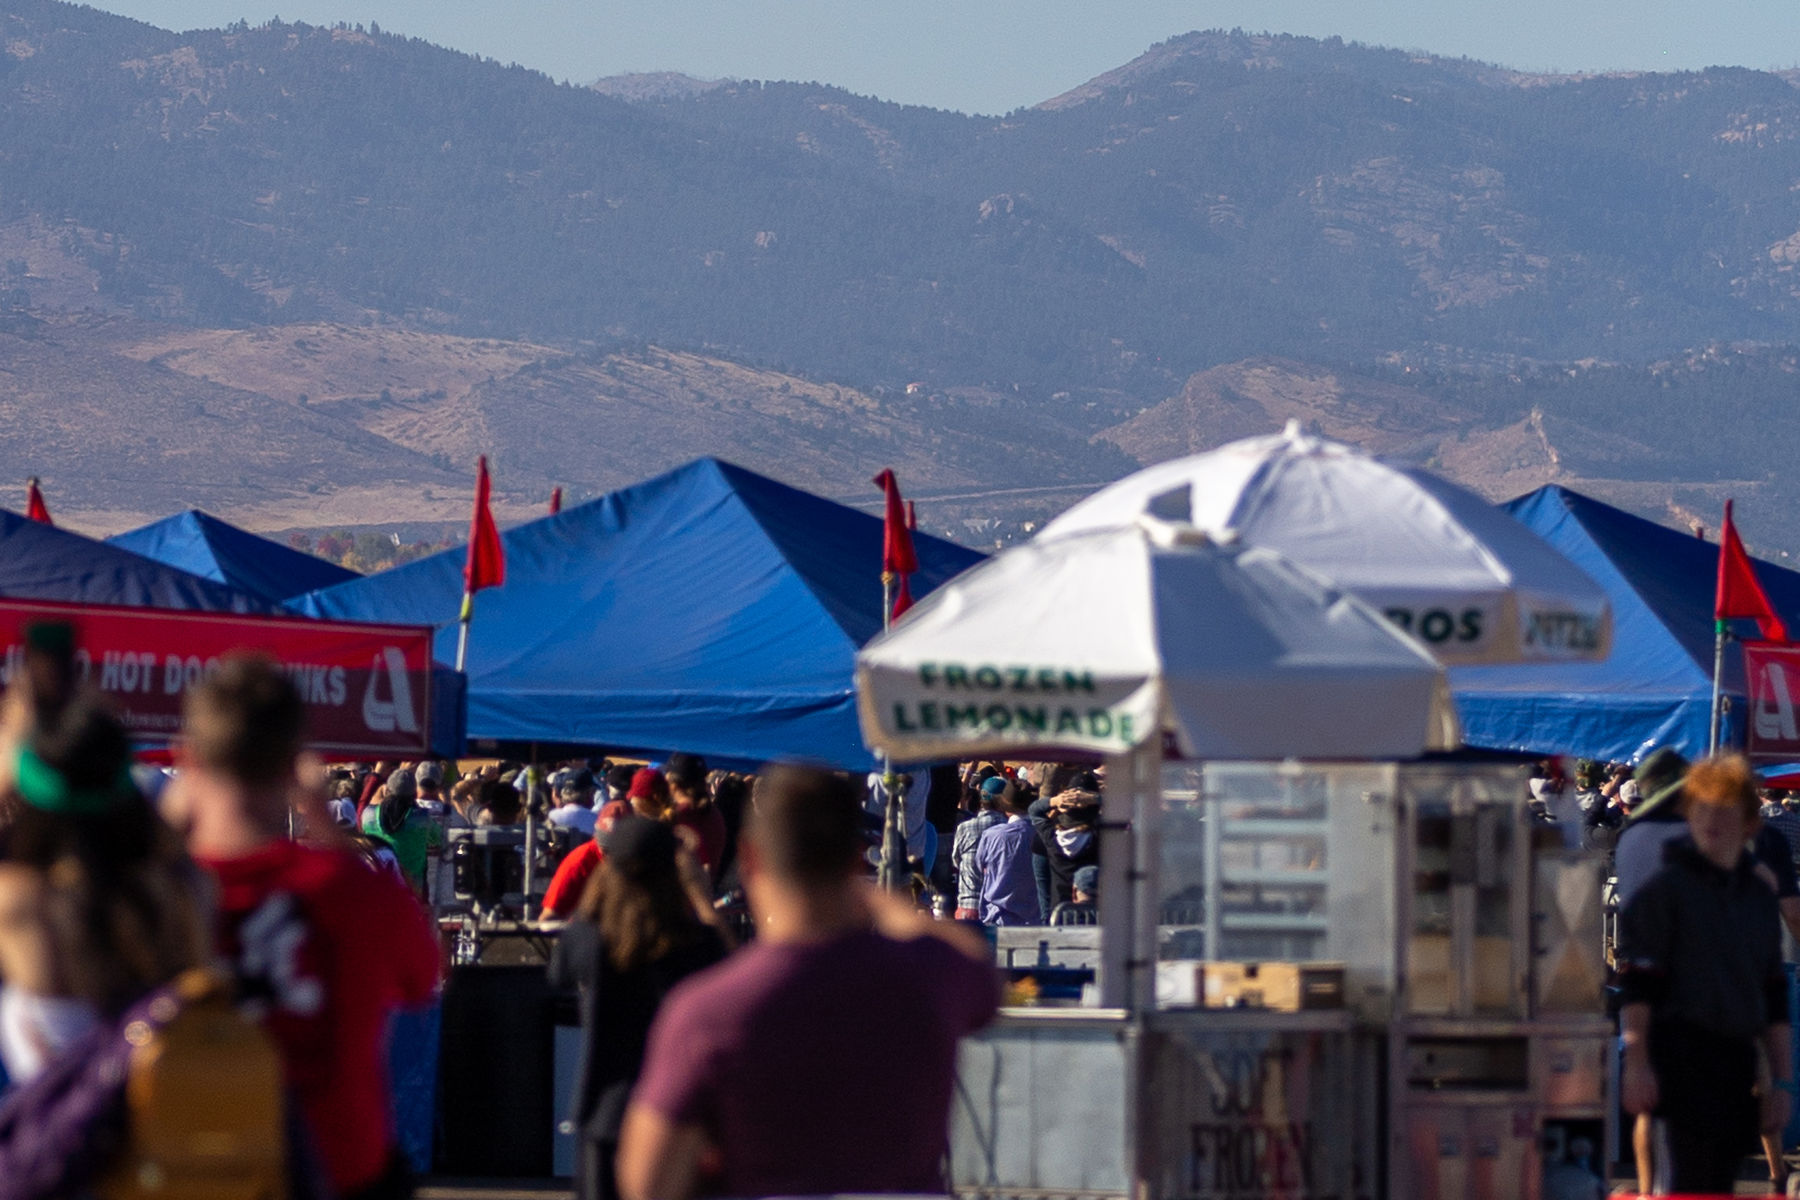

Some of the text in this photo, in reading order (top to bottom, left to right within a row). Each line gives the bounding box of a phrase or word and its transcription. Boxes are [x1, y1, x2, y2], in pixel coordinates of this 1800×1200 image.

[102, 650, 156, 693] HOT
[918, 662, 1097, 693] FROZEN
[893, 702, 1137, 747] LEMONADE
